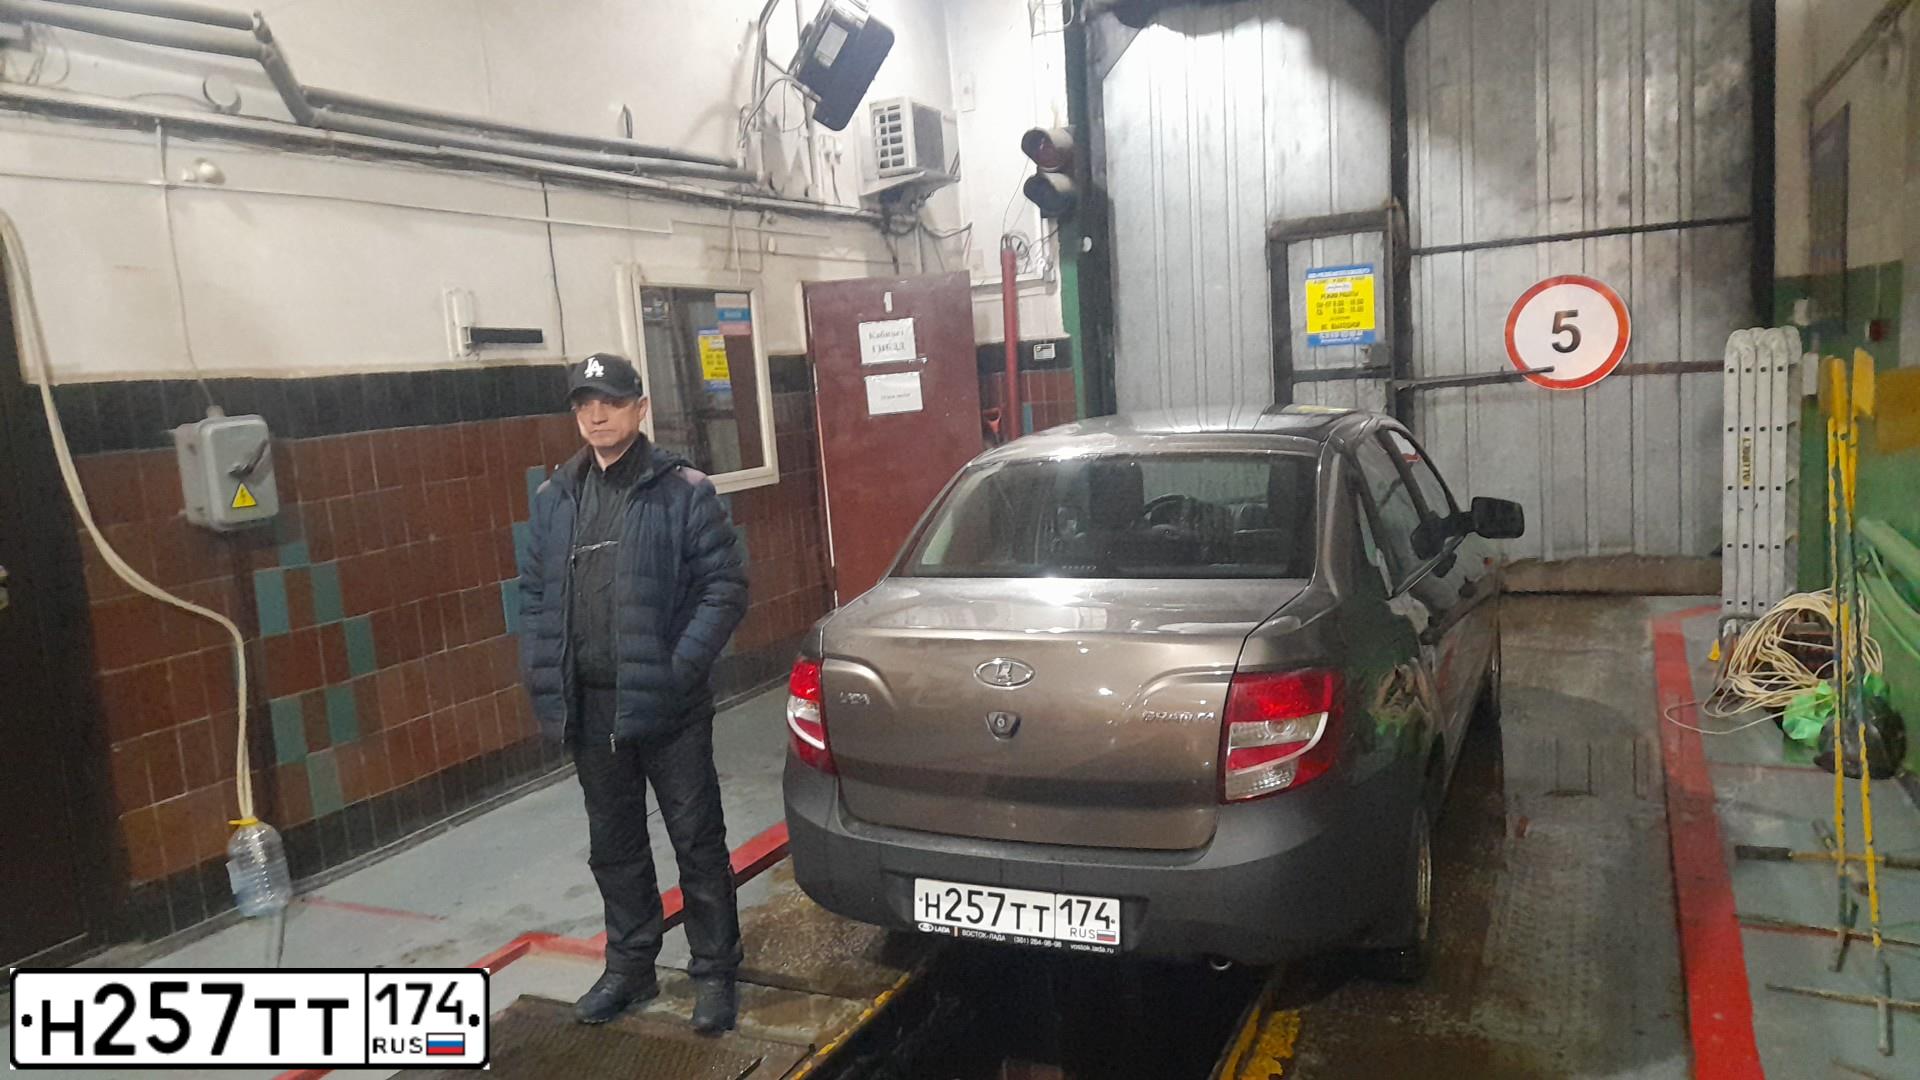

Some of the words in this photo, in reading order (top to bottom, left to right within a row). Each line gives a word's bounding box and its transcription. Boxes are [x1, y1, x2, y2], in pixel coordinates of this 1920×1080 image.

[883, 291, 893, 313] 1
[1552, 309, 1581, 353] 5
[584, 357, 604, 378] LA
[1059, 898, 1111, 930] 174
[1069, 927, 1096, 940] RUS
